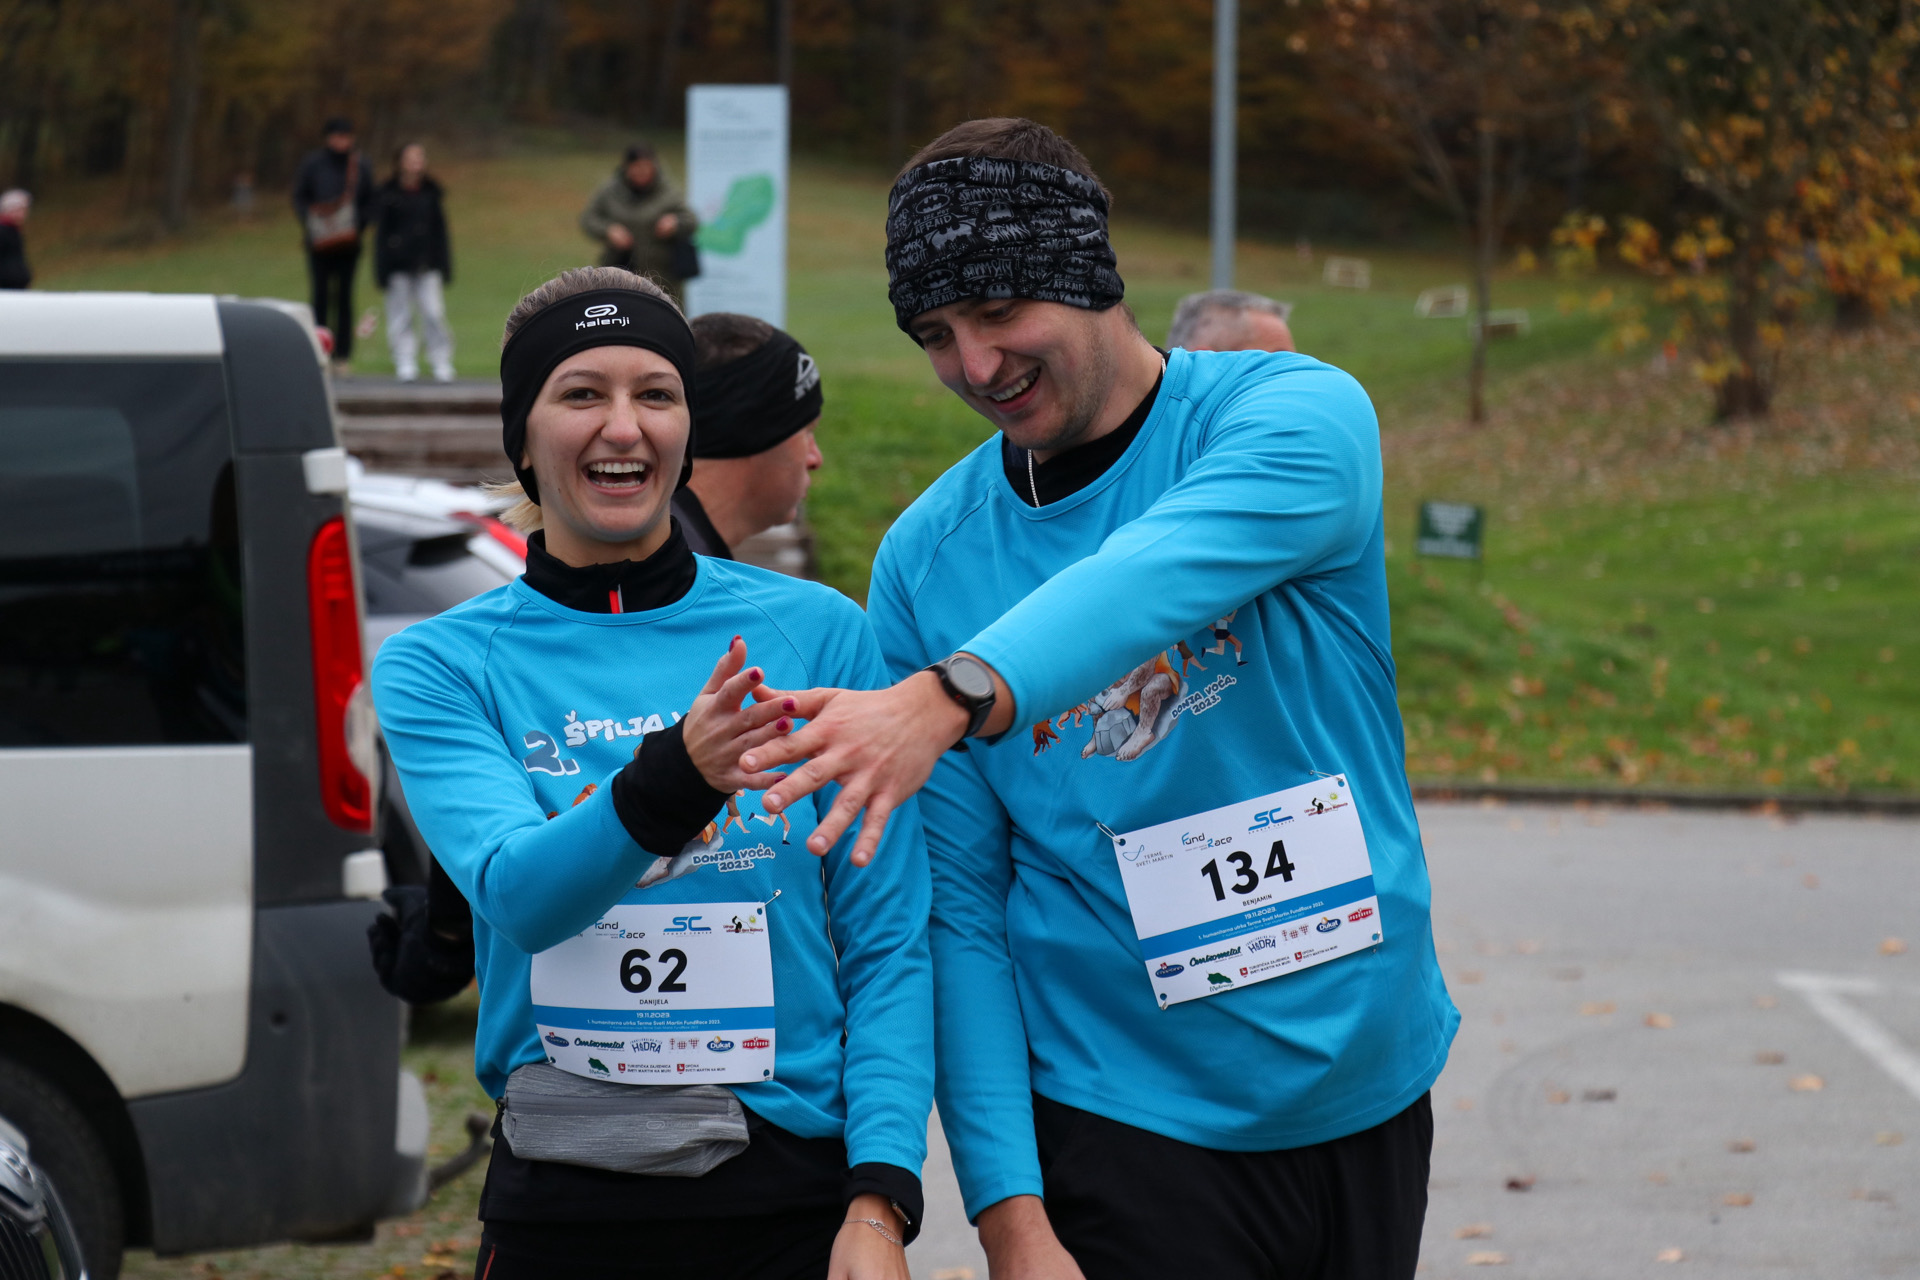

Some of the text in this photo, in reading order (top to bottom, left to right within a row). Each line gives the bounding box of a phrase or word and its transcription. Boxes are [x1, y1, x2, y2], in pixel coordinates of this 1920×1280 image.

[915, 215, 952, 236] AFRAID
[923, 293, 957, 310] AFRAID
[576, 317, 630, 331] Kalenji
[1172, 675, 1237, 720] DONJA VOĆA,
[1191, 694, 1222, 716] 2023.
[523, 710, 665, 776] 2. ŠPILJA
[1248, 807, 1294, 831] SC
[692, 843, 776, 866] DONJA VOĆA,
[719, 860, 755, 873] 2023.
[1201, 840, 1295, 902] 134
[1243, 894, 1273, 907] BENJAMIN
[663, 916, 712, 932] SC
[1320, 920, 1339, 931] Dukat
[620, 948, 688, 992] 62
